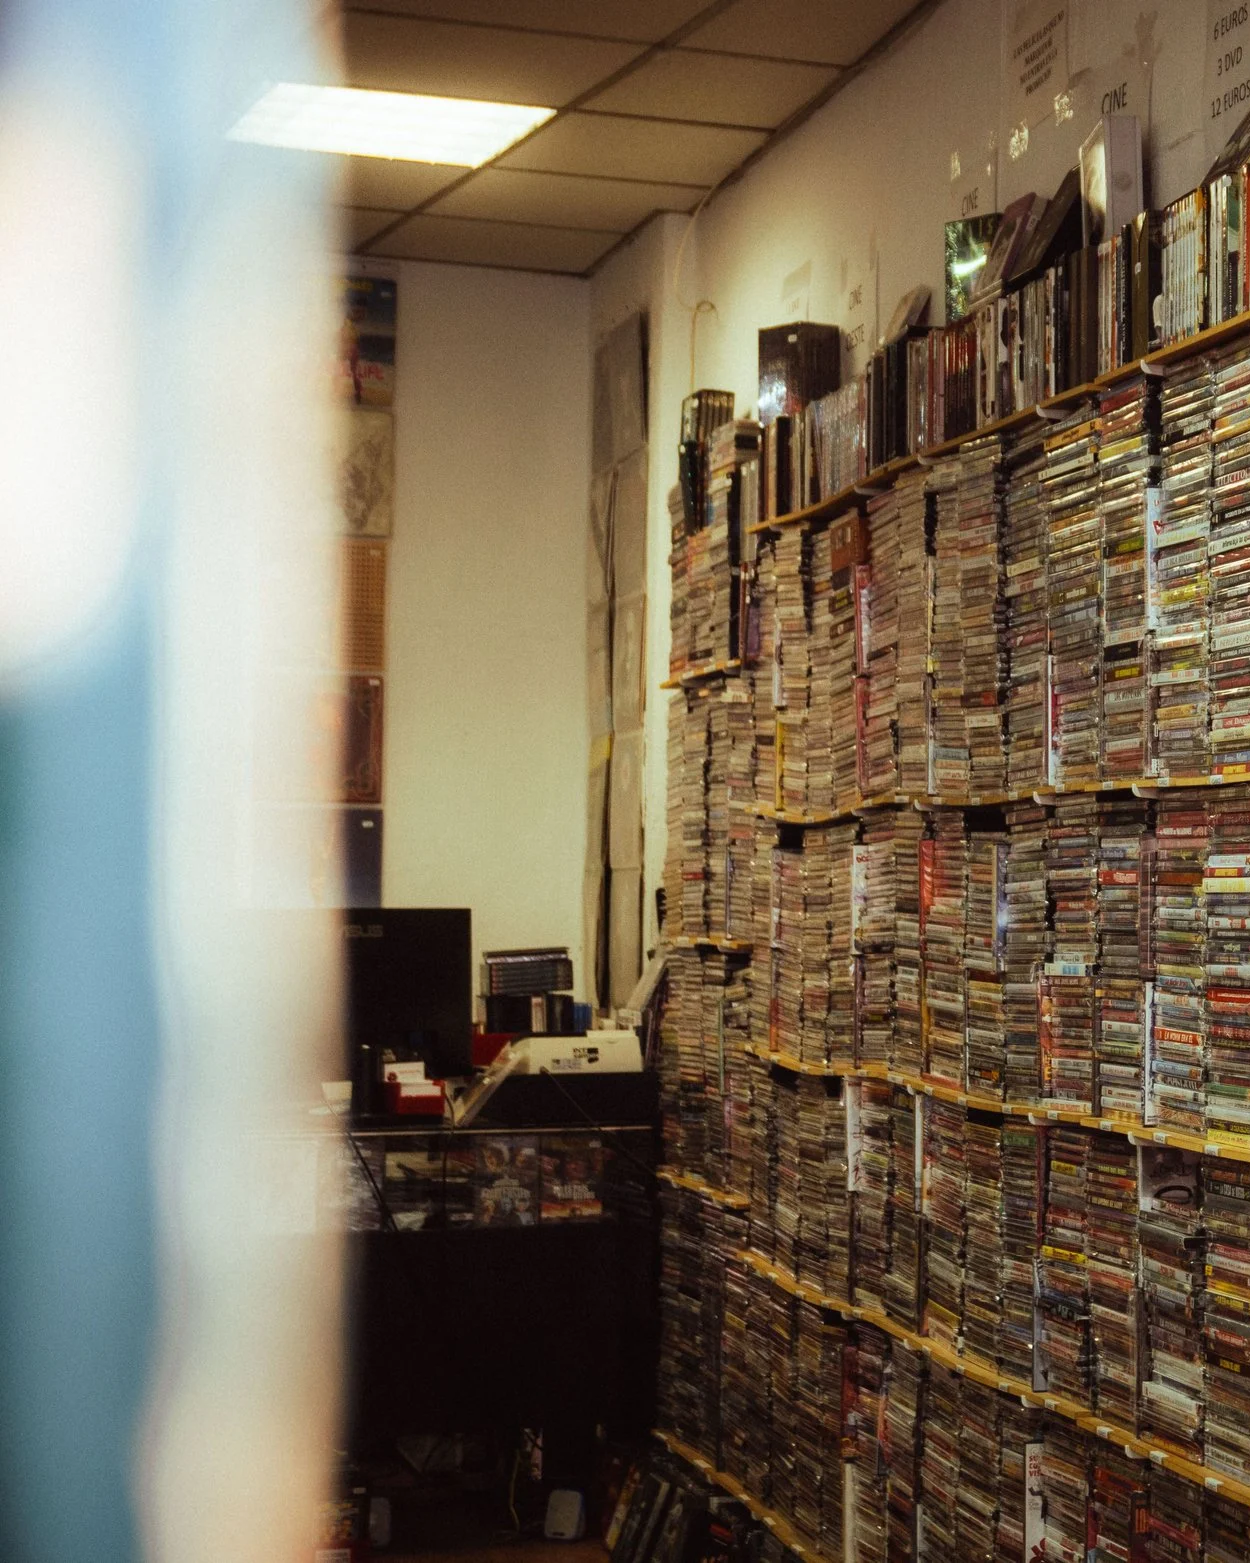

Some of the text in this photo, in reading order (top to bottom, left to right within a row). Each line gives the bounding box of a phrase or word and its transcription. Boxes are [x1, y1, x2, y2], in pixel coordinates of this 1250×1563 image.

[1213, 3, 1249, 40] 6 EUROS
[1217, 46, 1243, 76] 3 DVD
[1101, 82, 1128, 114] CINE
[1211, 79, 1250, 118] 12 EUROS
